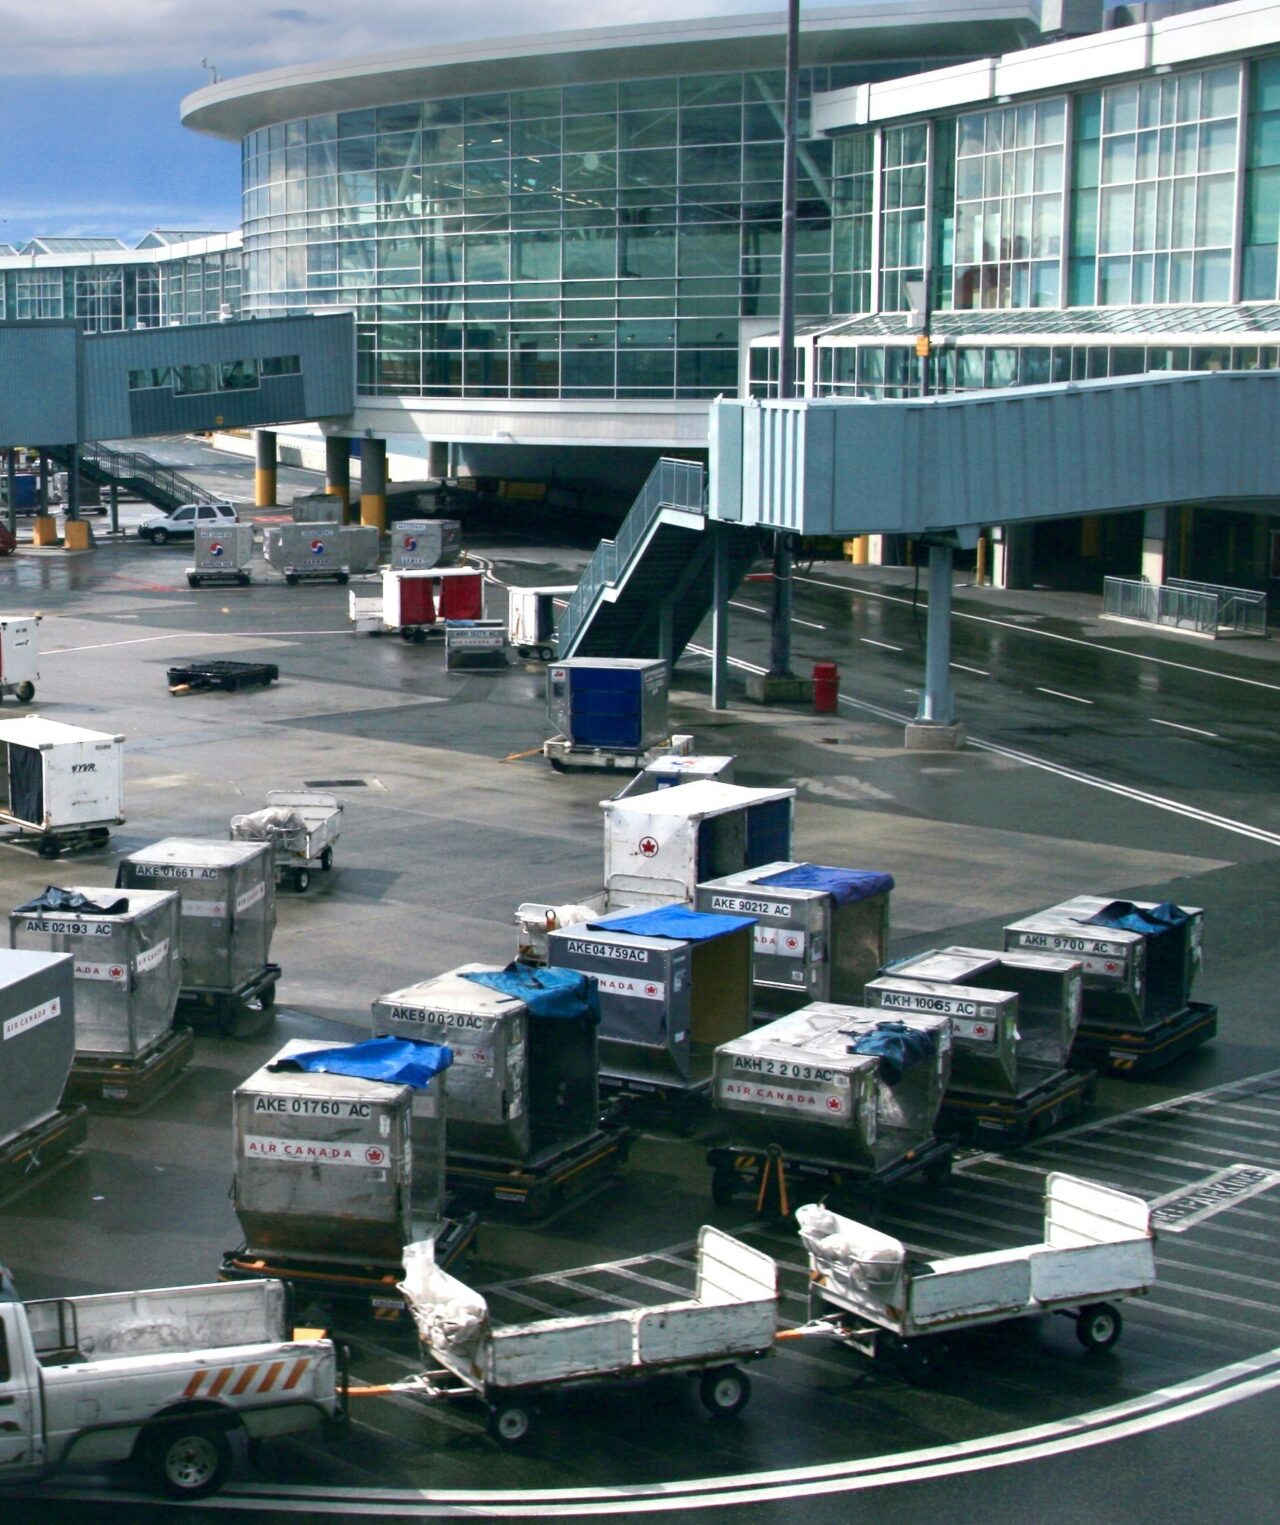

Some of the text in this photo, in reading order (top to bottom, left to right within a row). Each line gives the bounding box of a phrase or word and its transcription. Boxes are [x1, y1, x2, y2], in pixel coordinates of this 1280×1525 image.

[137, 866, 159, 876] AKE
[201, 869, 217, 879] AC
[713, 897, 790, 917] AKE 90212 AC
[27, 921, 111, 935] AKE 02193 AC
[1024, 935, 1108, 954] AKH 9700 AC
[599, 978, 635, 992] NADA
[883, 993, 974, 1016] AKH 10065 AC
[7, 1008, 47, 1033] AIR CANADA
[734, 1056, 762, 1071] AKH
[814, 1069, 833, 1082] AC
[726, 1084, 816, 1105] AIR CANADA
[256, 1098, 370, 1118] AKE 01760 AC
[249, 1142, 352, 1159] AIR CANADA
